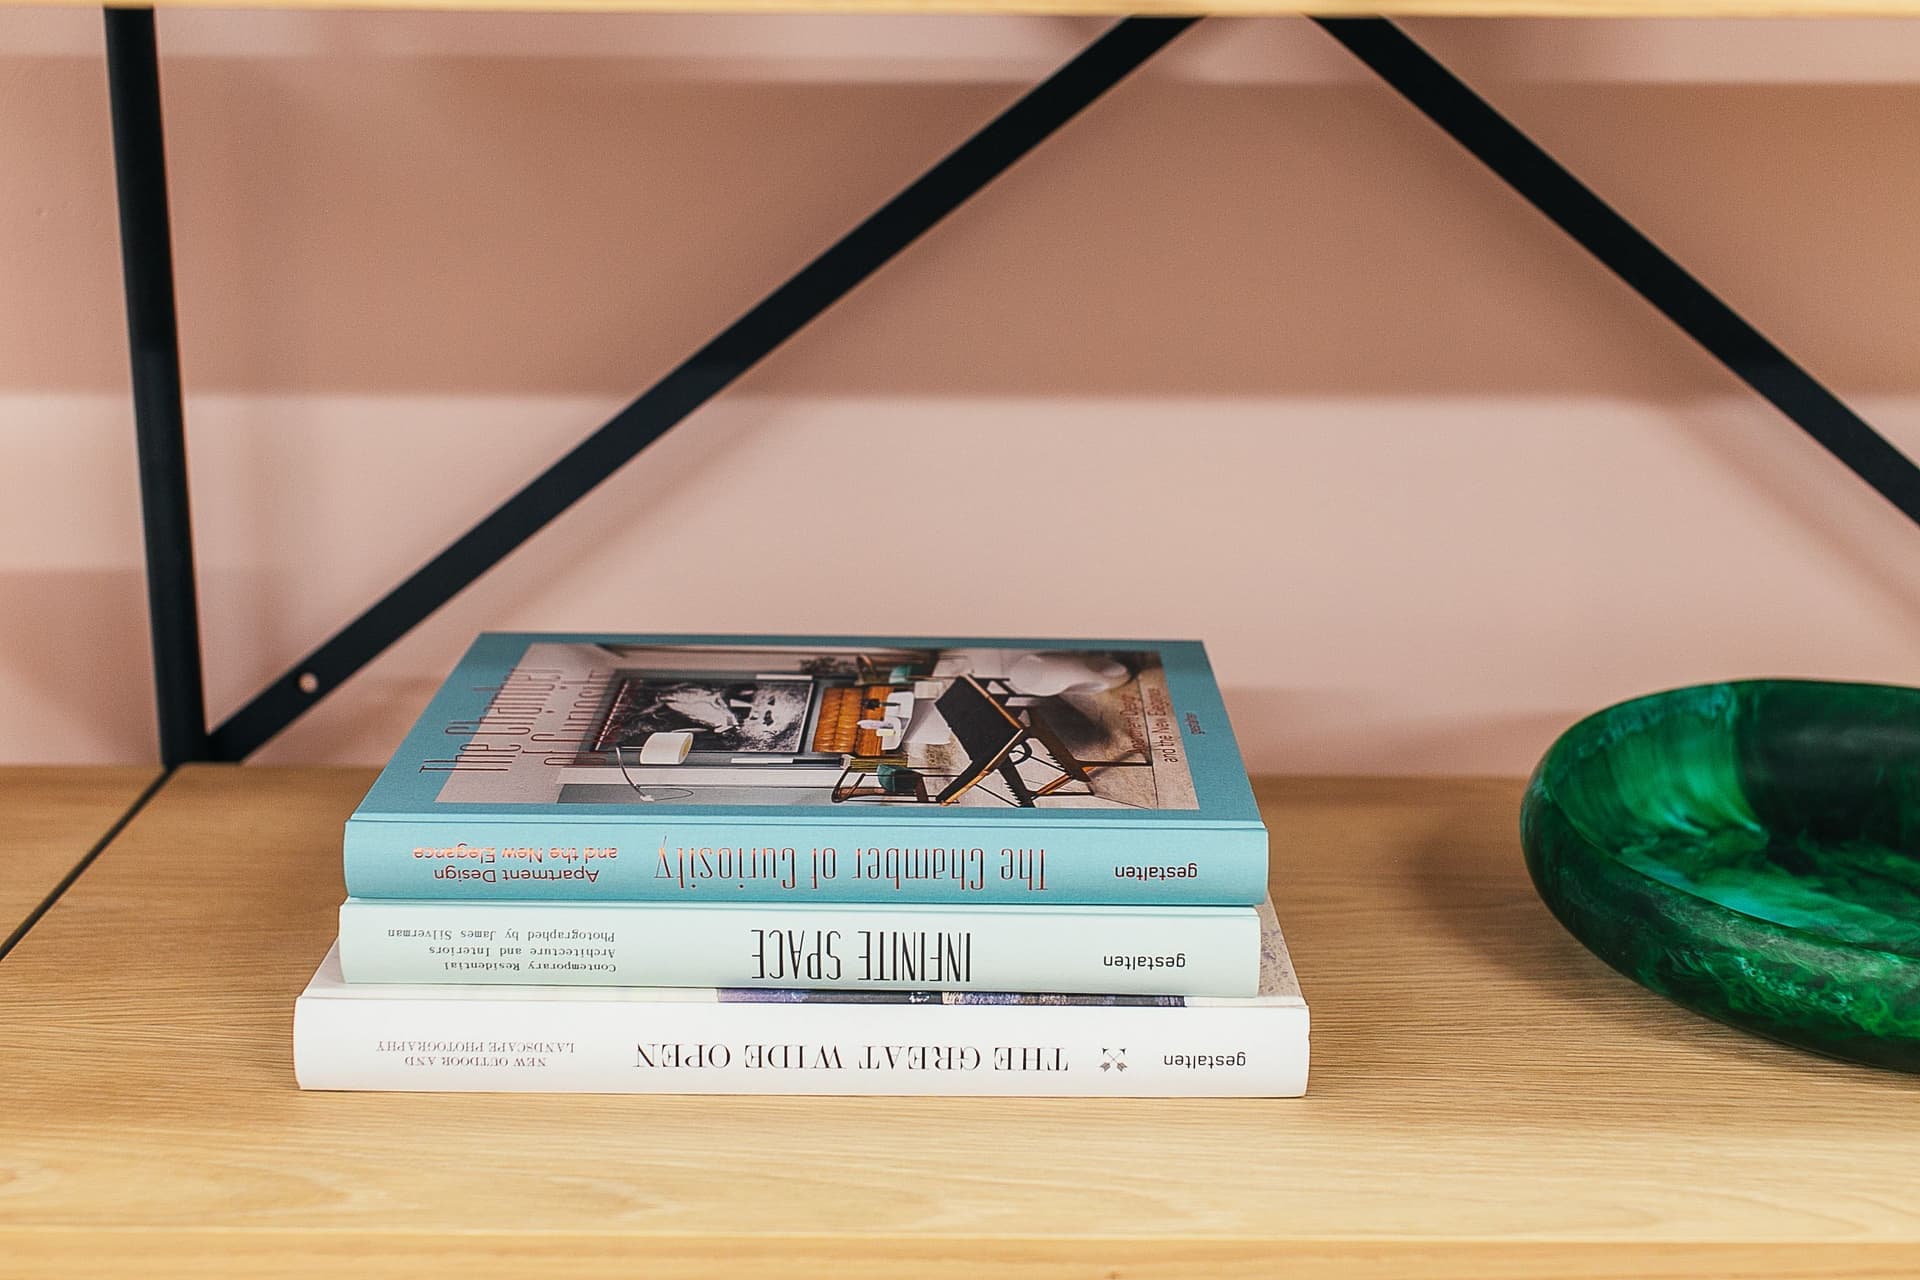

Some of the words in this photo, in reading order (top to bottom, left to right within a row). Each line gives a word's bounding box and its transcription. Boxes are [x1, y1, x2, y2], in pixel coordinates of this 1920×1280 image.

[419, 744, 521, 773] The
[1153, 748, 1178, 763] and
[412, 843, 496, 863] Elegance
[502, 848, 544, 862] New
[549, 848, 578, 864] the
[583, 848, 618, 864] and
[654, 834, 797, 890] Curiosity
[811, 848, 836, 890] of
[853, 848, 985, 891] Chamber
[1000, 848, 1048, 891] The
[434, 868, 496, 883] Design
[502, 868, 600, 883] Apartment
[1114, 862, 1198, 881] gestalten
[388, 930, 451, 940] Silverman
[461, 931, 496, 940] James
[505, 929, 518, 941] by
[528, 929, 614, 942] Photographed
[429, 947, 489, 956] Interiors
[500, 948, 521, 956] and
[530, 948, 615, 959] Architecture
[751, 930, 841, 980] SPACE
[858, 931, 970, 982] INFINITE
[445, 962, 519, 971] Residential
[529, 961, 616, 972] Contemporary
[1104, 953, 1185, 970] gestalten
[376, 1041, 483, 1052] PHOTOGRAPHY
[489, 1042, 573, 1053] LANDSCAPE
[405, 1057, 435, 1066] AND
[442, 1057, 508, 1066] OUTDOOR
[514, 1058, 545, 1066] NEW
[634, 1044, 730, 1067] OPEN
[745, 1045, 846, 1068] WIDE
[859, 1047, 980, 1069] GREAT
[995, 1048, 1068, 1070] THE
[1164, 1052, 1245, 1069] gestalten
